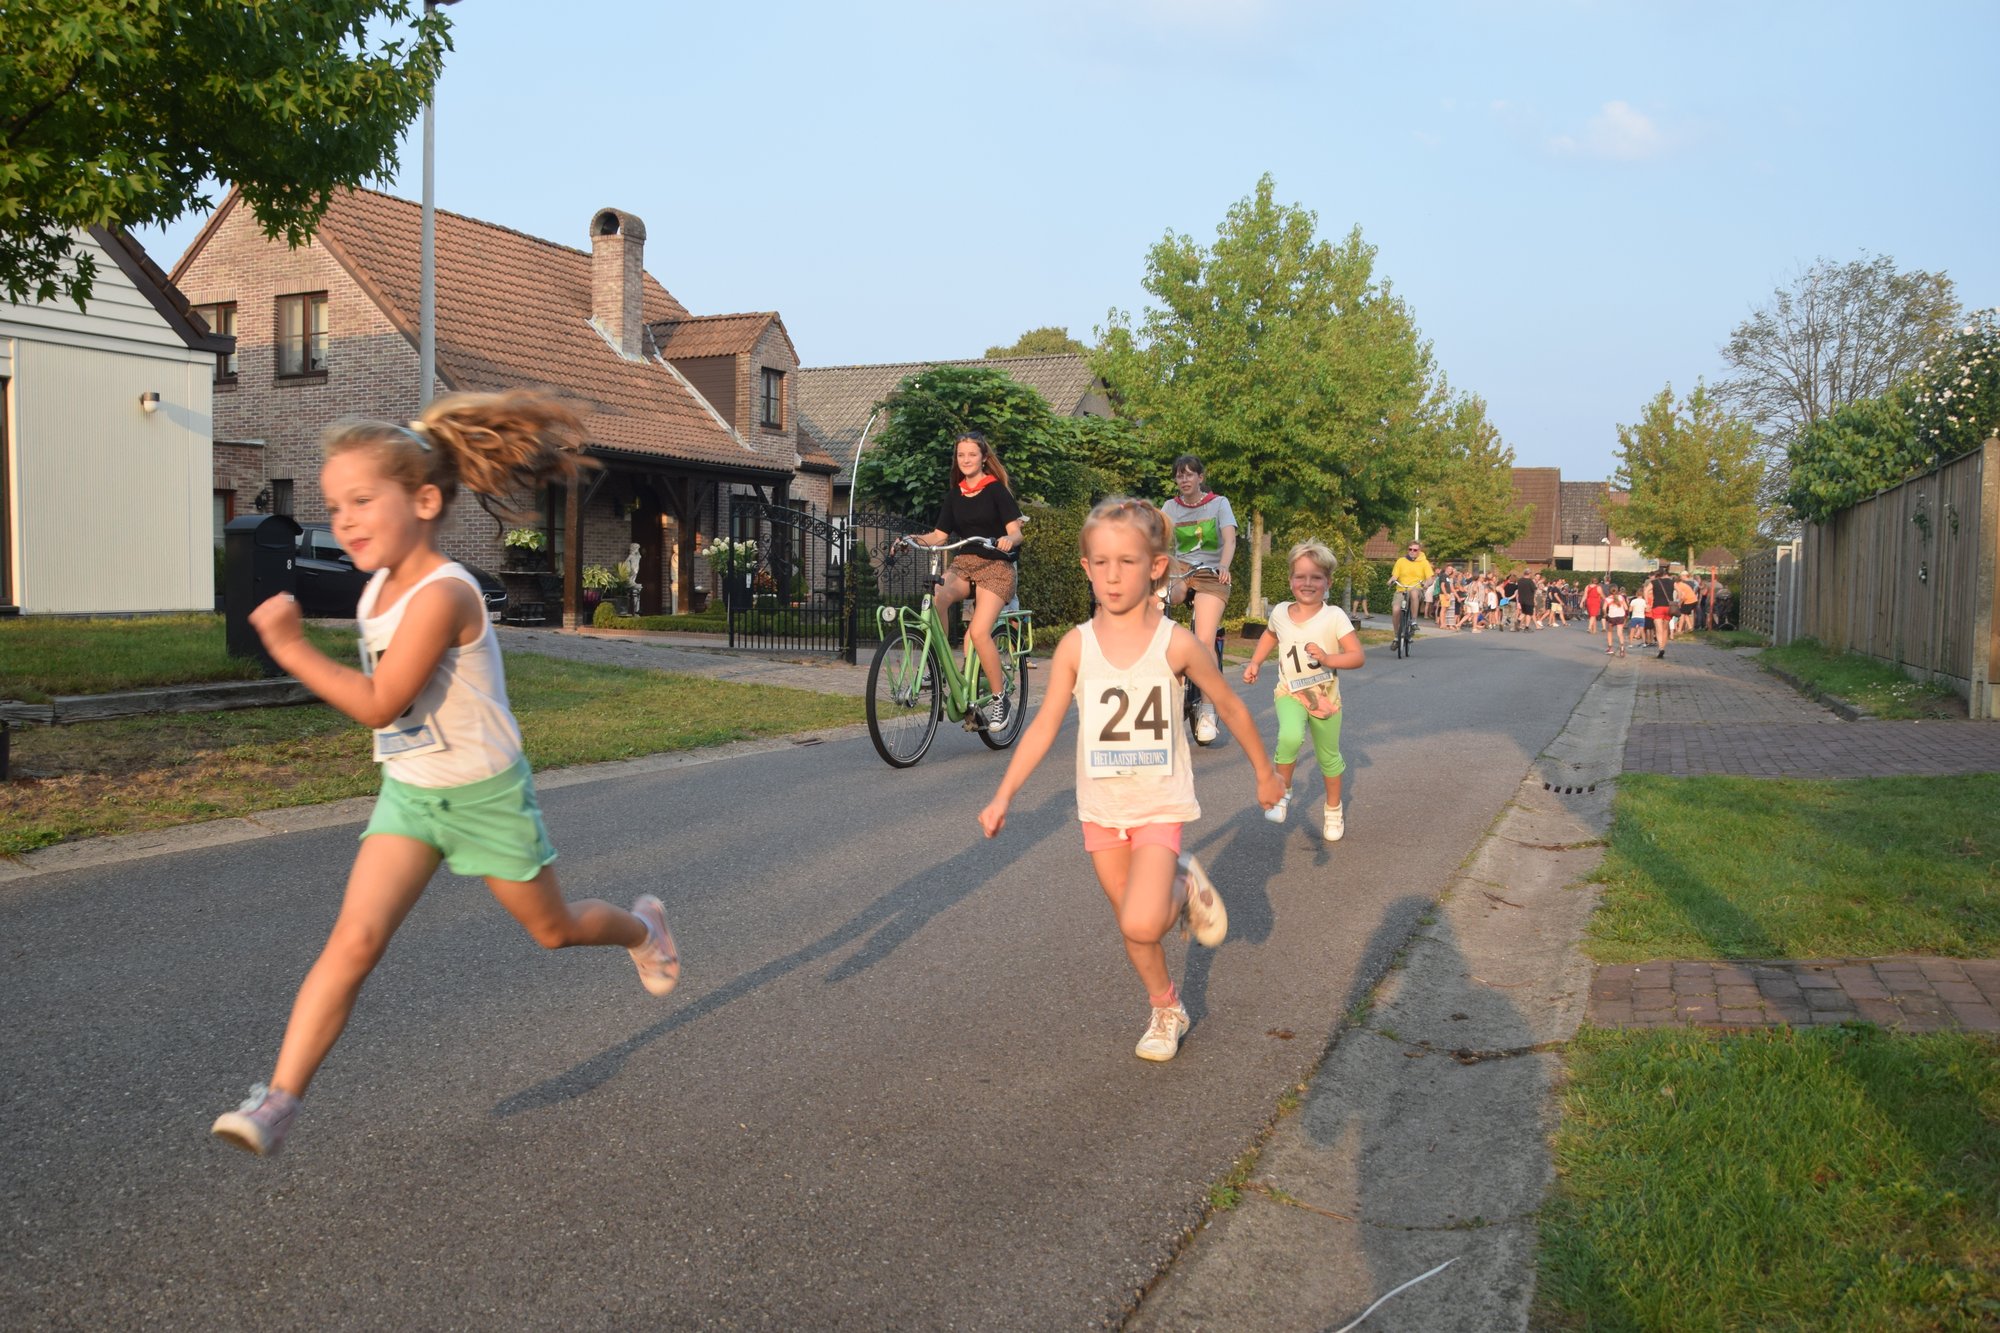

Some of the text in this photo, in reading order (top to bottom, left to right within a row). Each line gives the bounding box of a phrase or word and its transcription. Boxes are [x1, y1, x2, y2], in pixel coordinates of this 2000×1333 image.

[286, 559, 292, 570] 8
[1099, 686, 1168, 741] 24
[1094, 750, 1165, 766] HET LAATSTE NIEUWS
